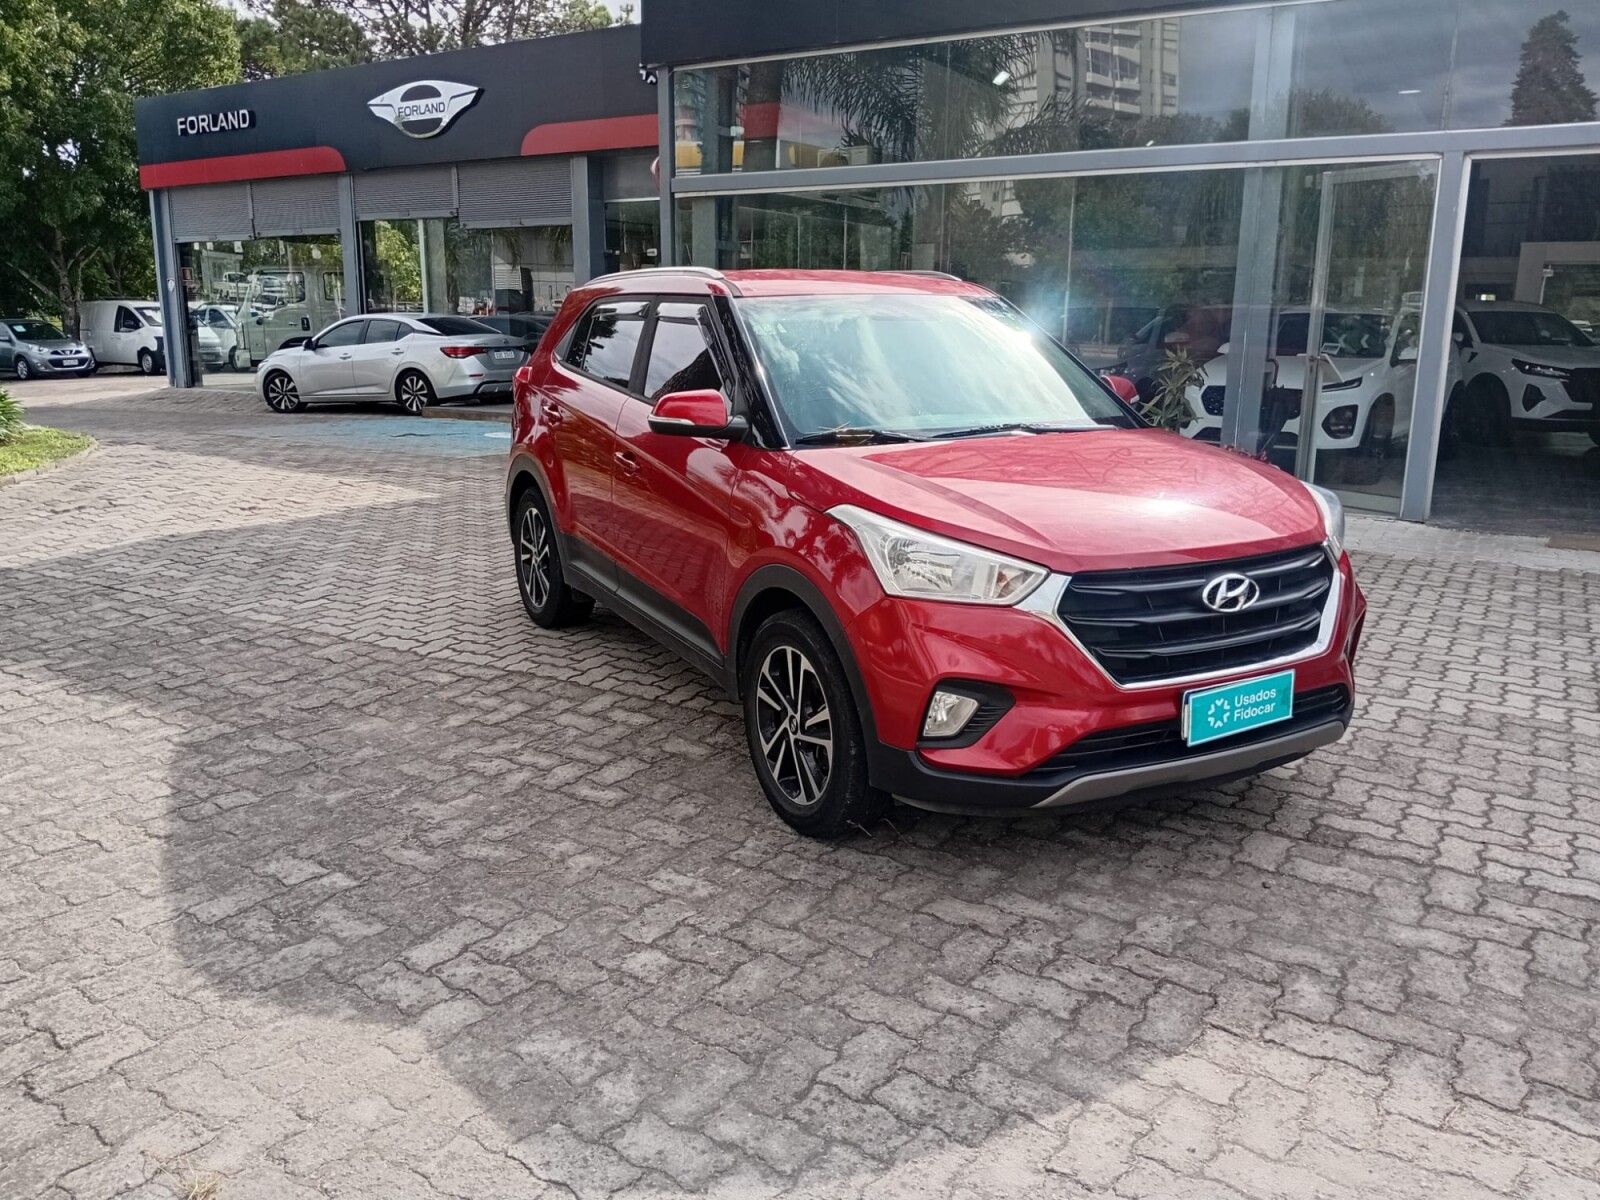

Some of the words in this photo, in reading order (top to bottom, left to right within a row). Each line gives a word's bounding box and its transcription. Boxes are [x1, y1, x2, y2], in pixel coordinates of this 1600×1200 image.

[398, 102, 446, 117] FORLAND
[177, 109, 250, 136] FORLAND
[1234, 688, 1277, 708] Usados
[1233, 702, 1276, 722] Fidocar
